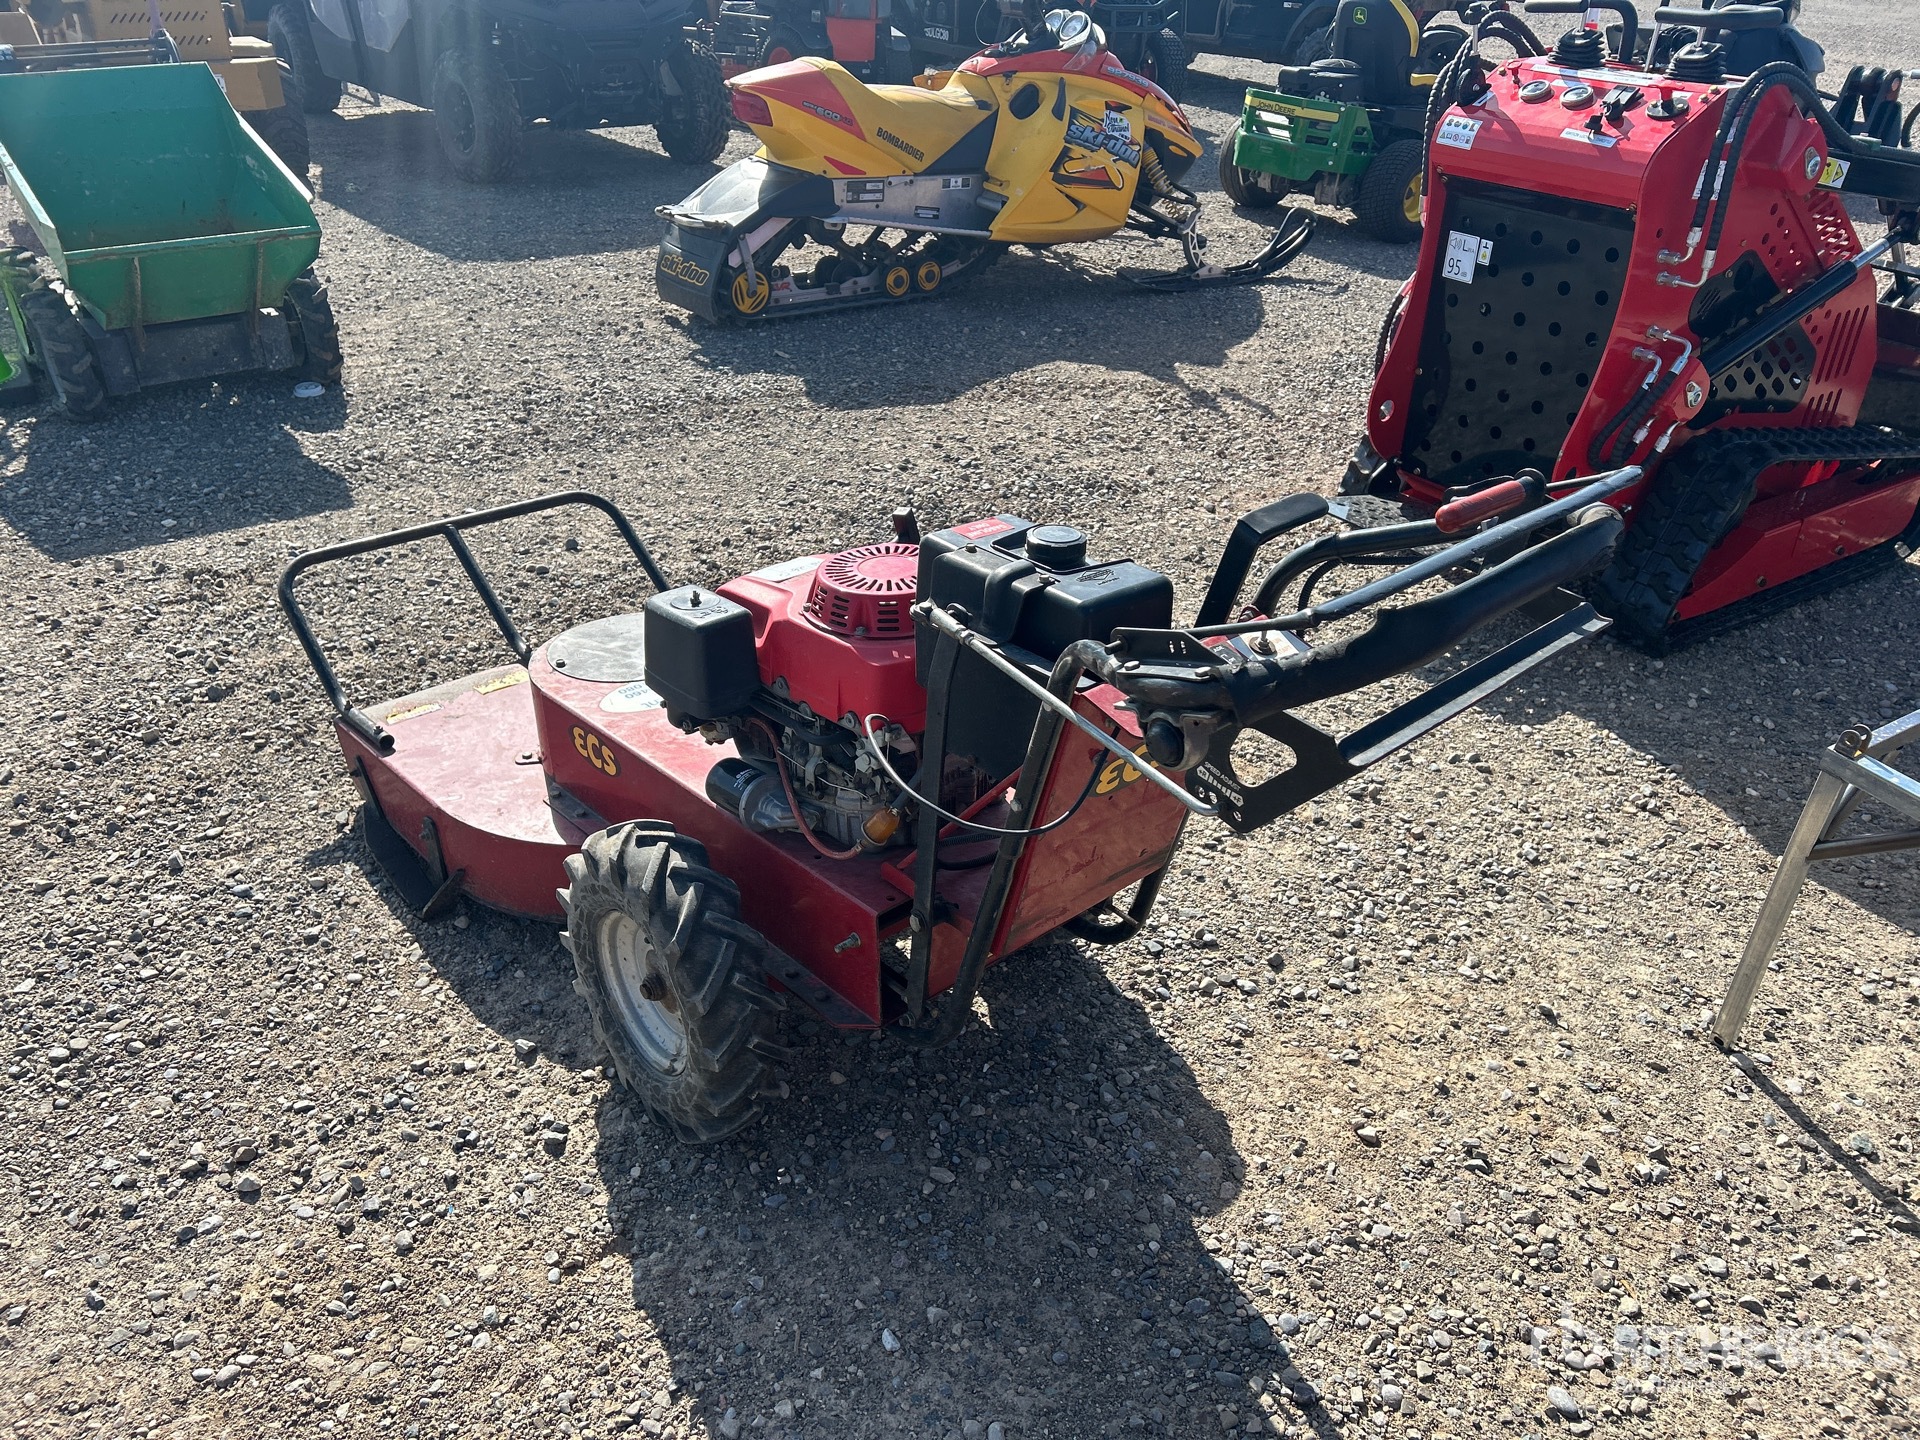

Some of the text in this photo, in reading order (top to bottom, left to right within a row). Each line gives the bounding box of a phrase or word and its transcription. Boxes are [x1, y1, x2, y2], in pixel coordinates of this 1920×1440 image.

[1256, 101, 1297, 116] JOHN DEERE
[876, 126, 925, 162] BOMBARDIER
[1447, 257, 1461, 276] 95
[572, 726, 617, 776] ECS
[1204, 761, 1241, 792] SPEED ADJUST
